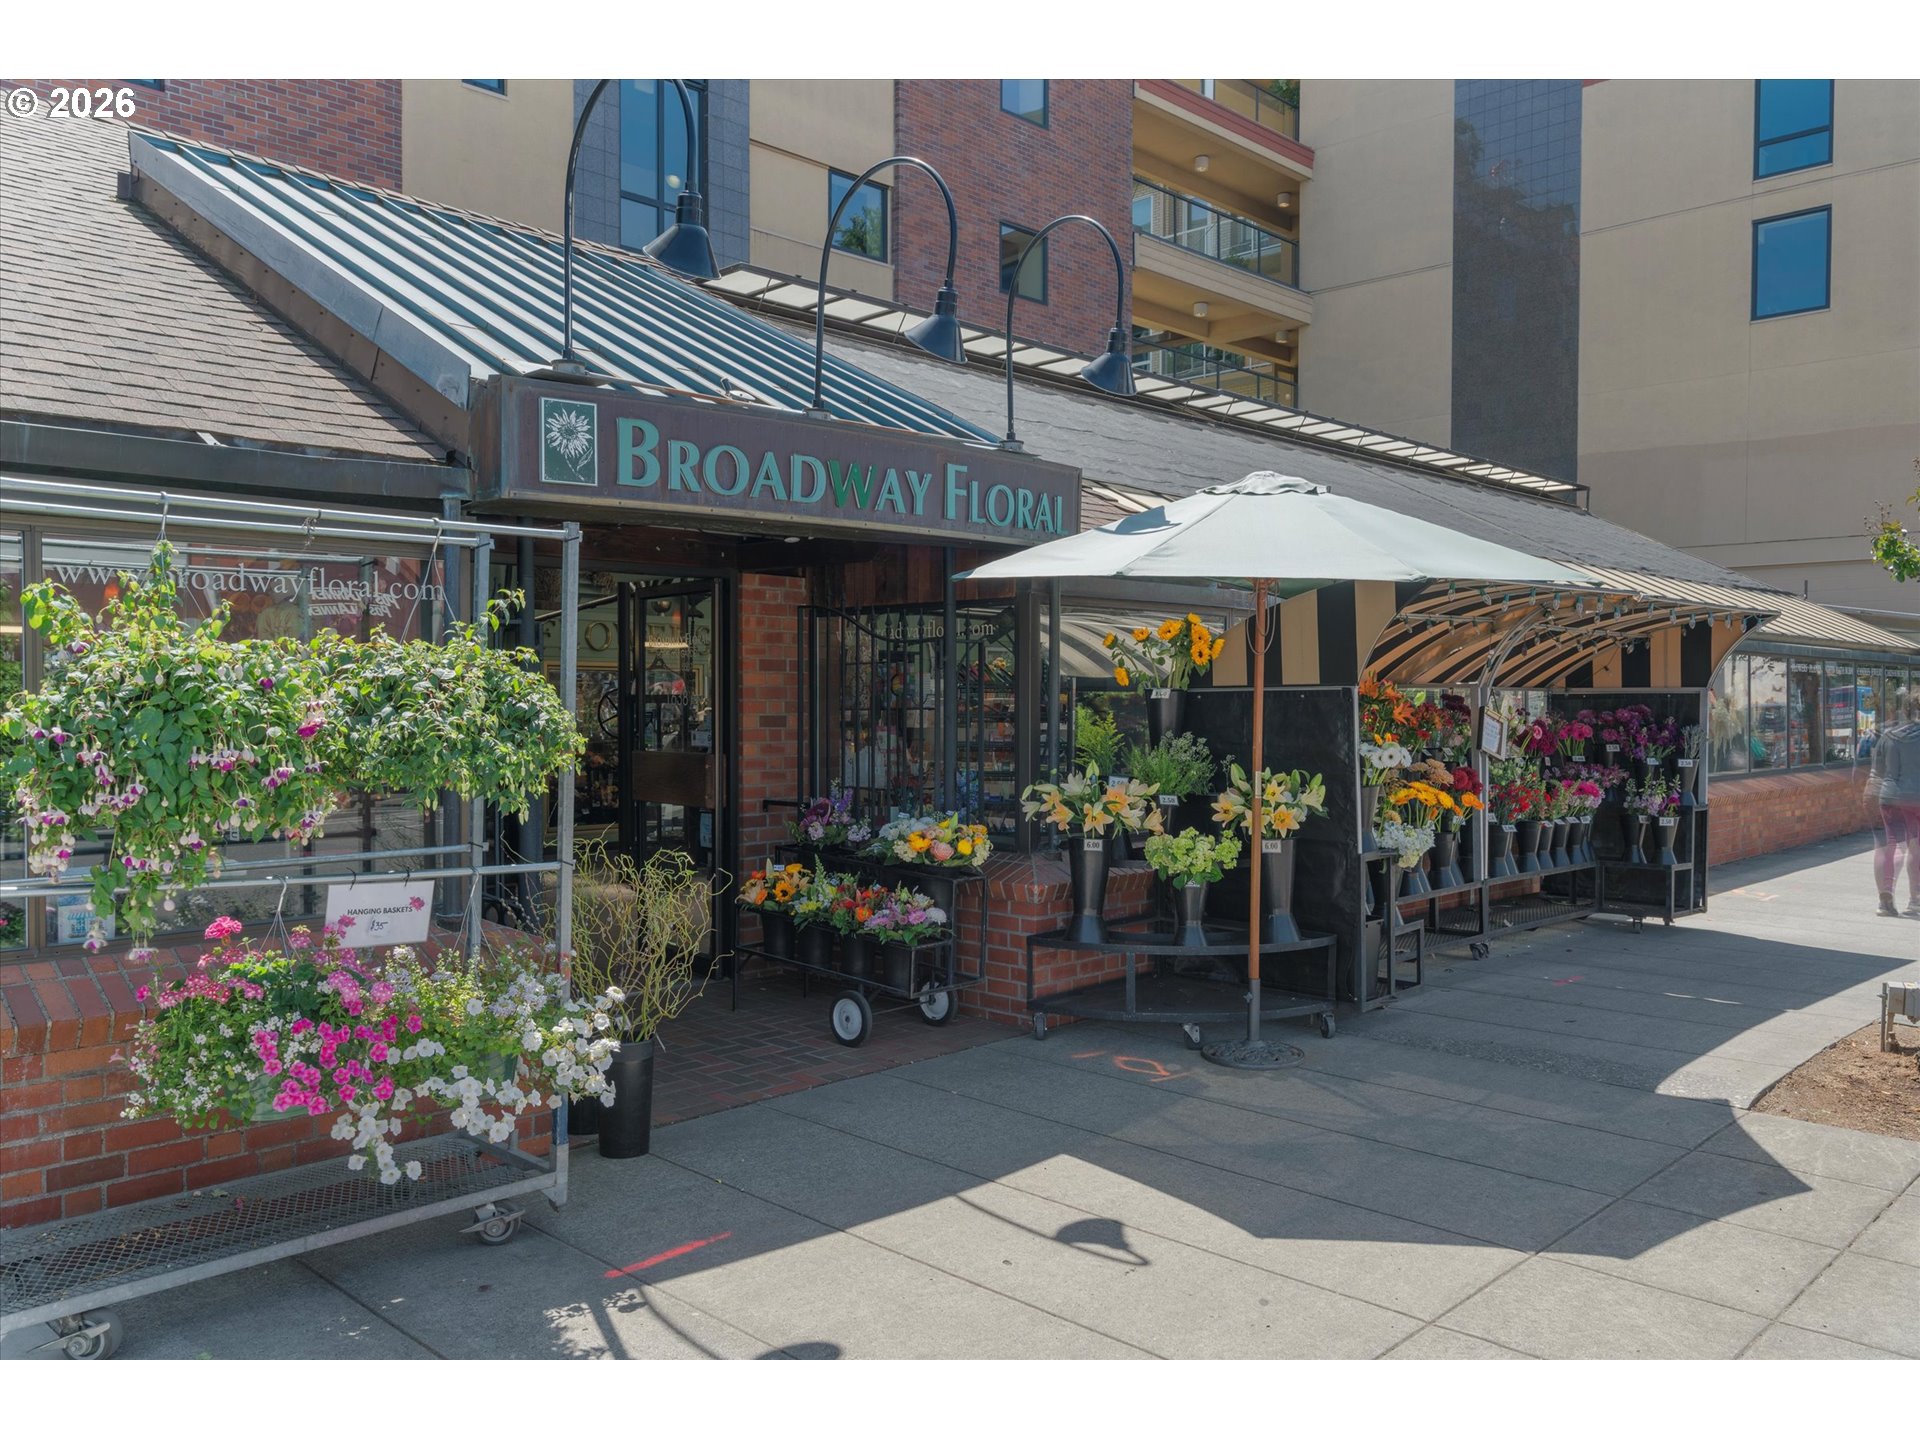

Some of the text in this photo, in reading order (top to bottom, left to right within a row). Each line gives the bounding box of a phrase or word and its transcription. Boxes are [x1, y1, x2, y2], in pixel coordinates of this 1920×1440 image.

[616, 416, 1069, 536] BROADWAY FLORAL
[1086, 841, 1100, 849] 6.00
[1264, 842, 1278, 850] 6.00
[347, 906, 413, 916] HANGING BASKETS
